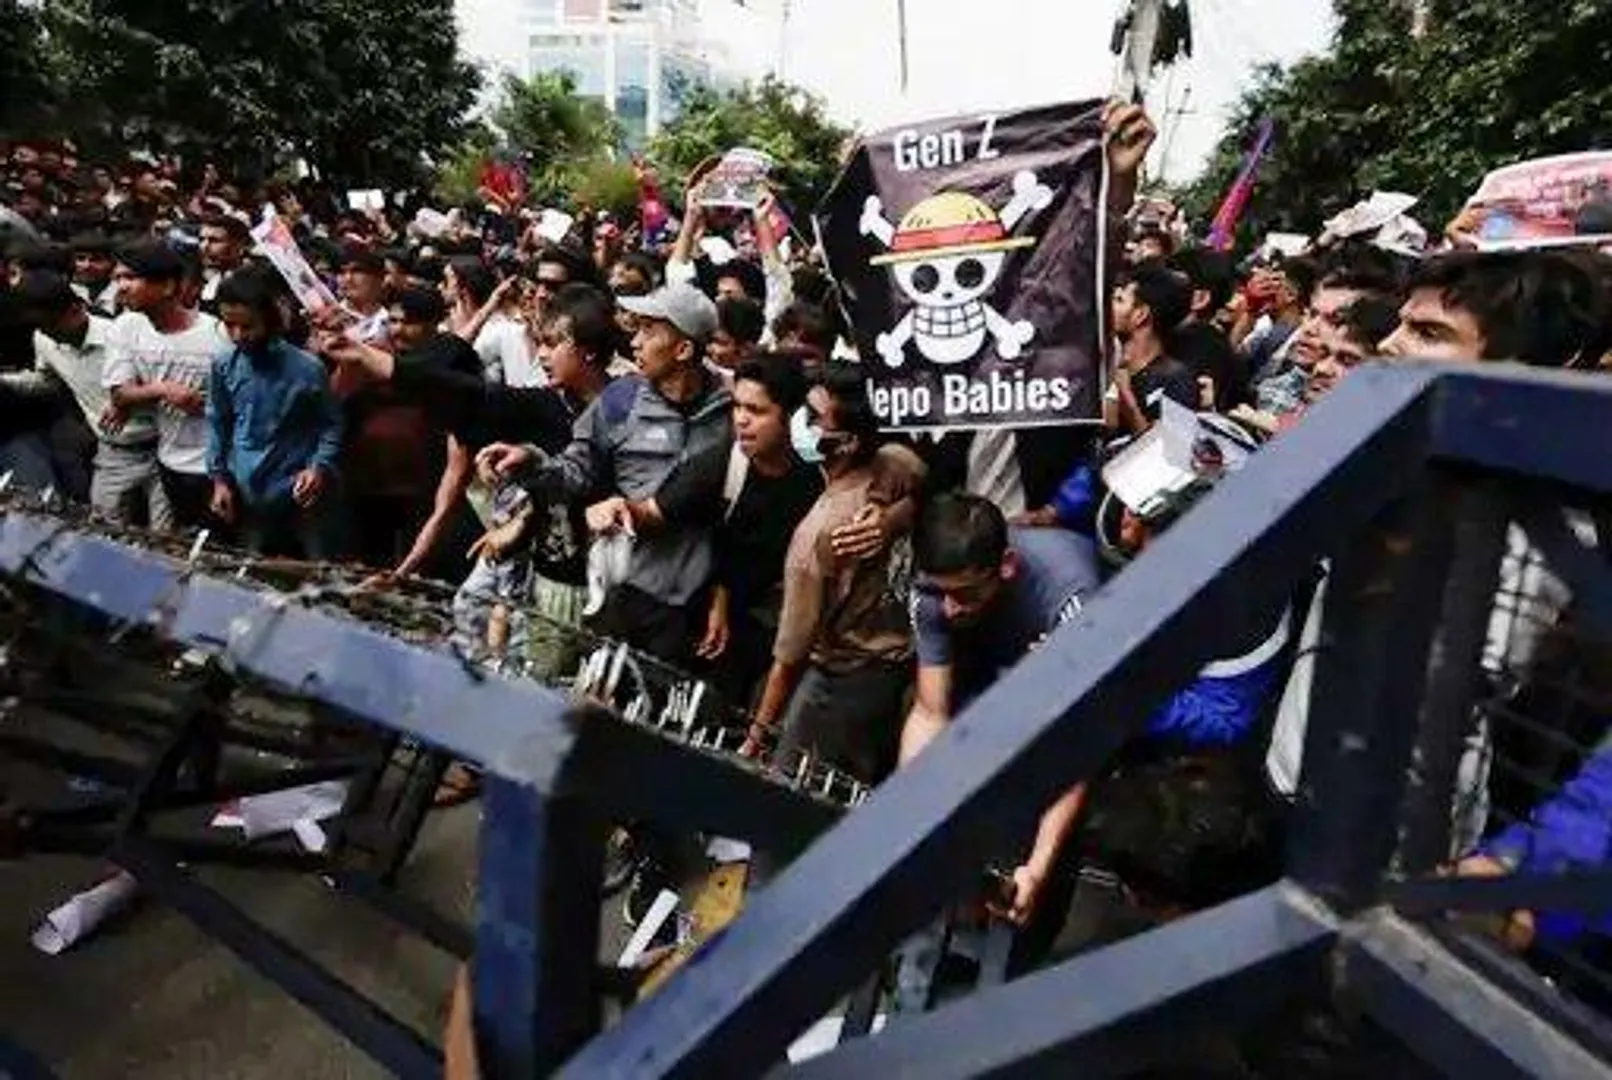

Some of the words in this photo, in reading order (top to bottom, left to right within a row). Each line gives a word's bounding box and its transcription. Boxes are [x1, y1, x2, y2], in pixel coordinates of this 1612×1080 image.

[894, 129, 964, 172] Gen
[976, 114, 1000, 159] Z
[943, 370, 1071, 416] Babies
